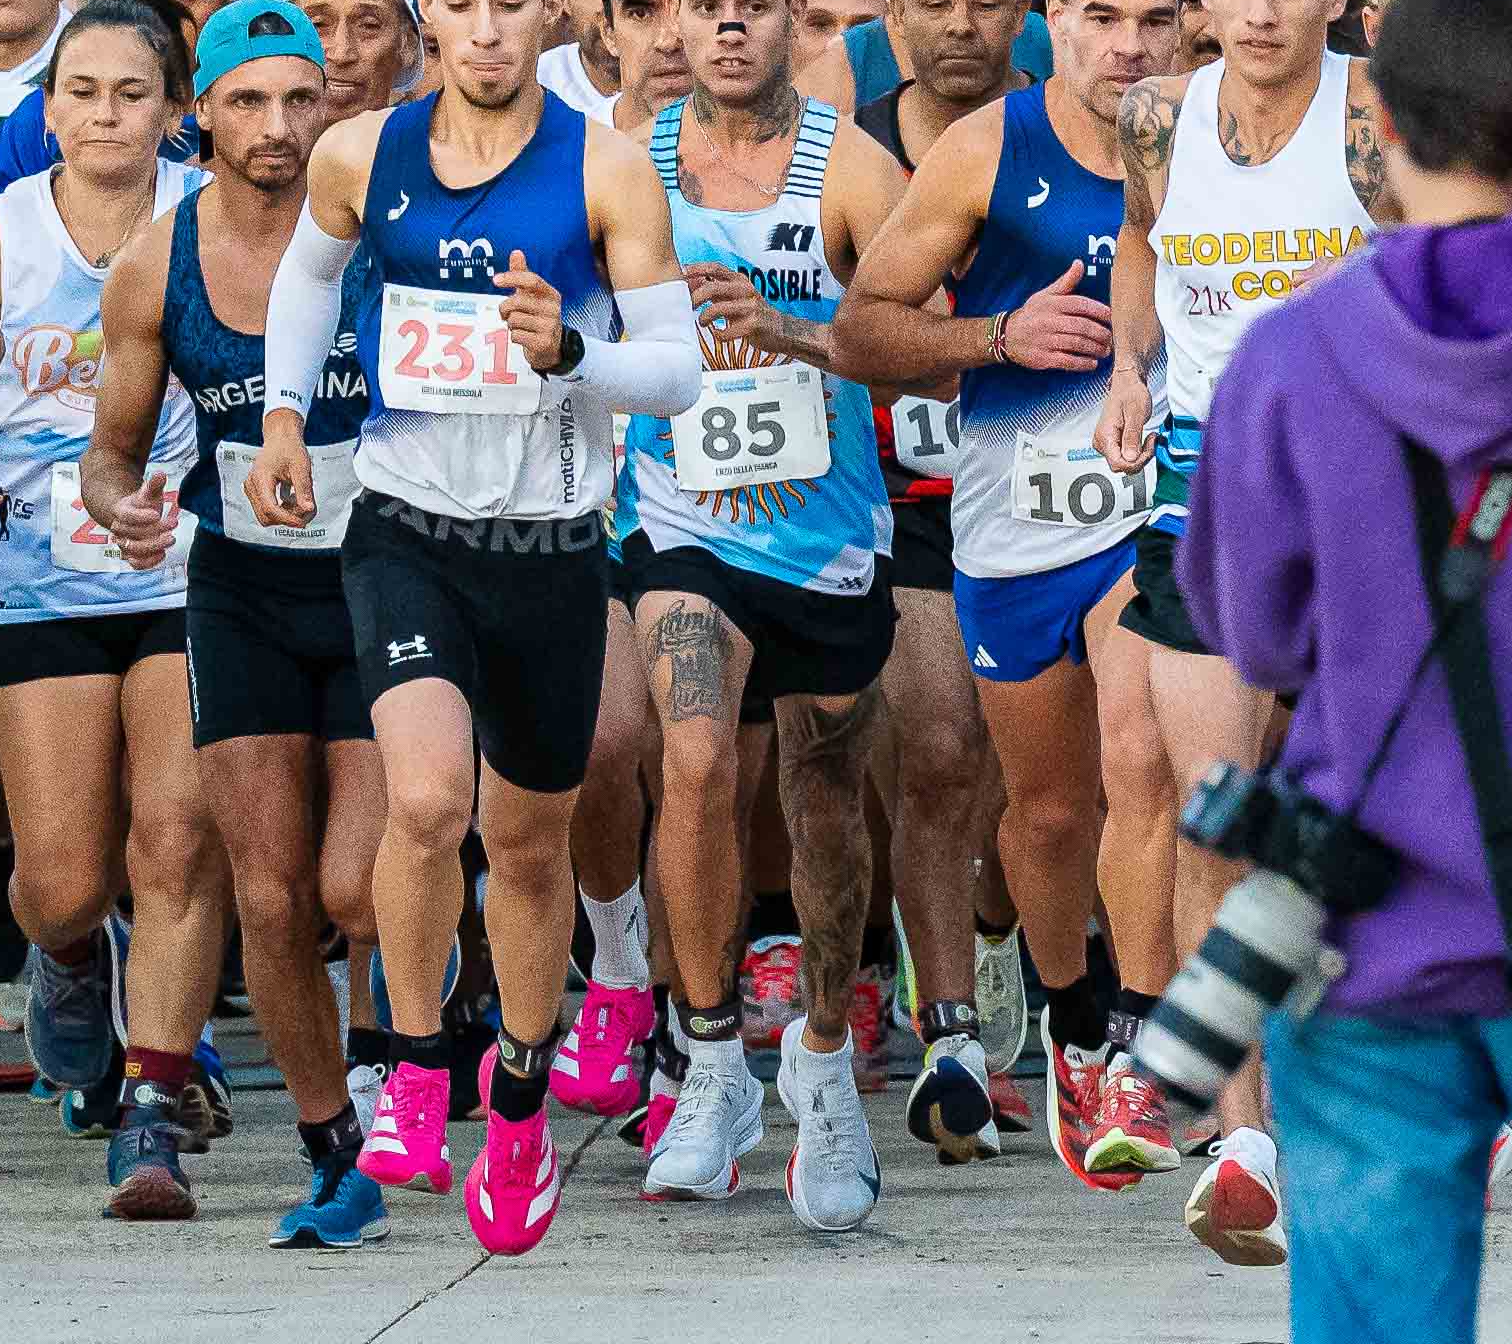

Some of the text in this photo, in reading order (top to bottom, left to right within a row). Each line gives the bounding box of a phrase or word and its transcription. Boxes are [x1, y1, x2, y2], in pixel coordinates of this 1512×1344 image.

[443, 258, 489, 268] running
[738, 267, 822, 303] OSIBLE
[394, 319, 518, 385] 231
[195, 371, 368, 414] ARGEINA
[701, 401, 786, 461] 85
[1028, 472, 1148, 525] 101
